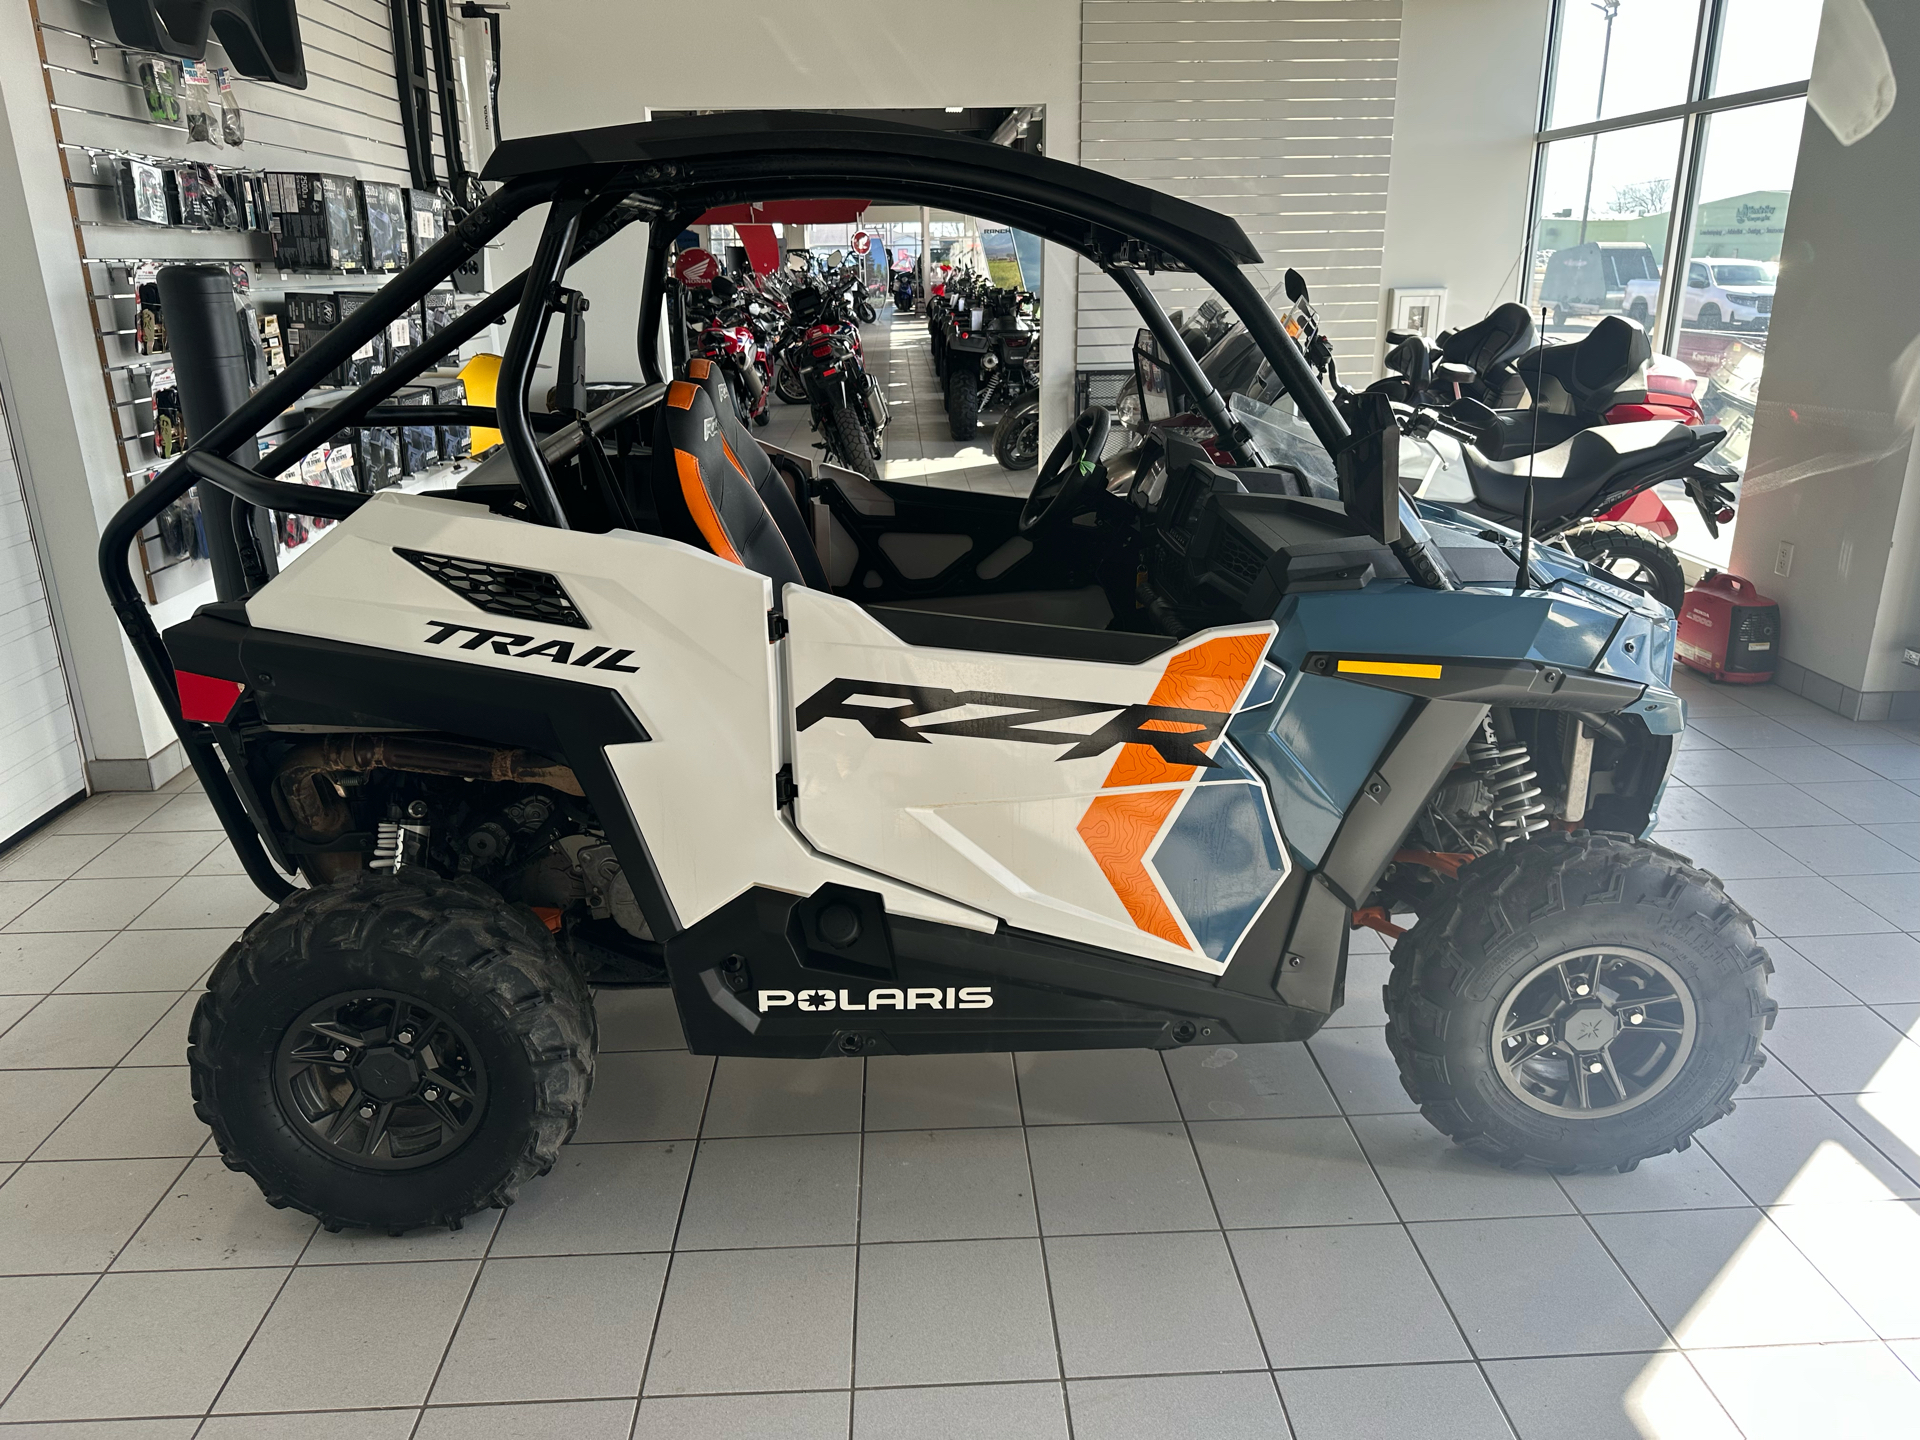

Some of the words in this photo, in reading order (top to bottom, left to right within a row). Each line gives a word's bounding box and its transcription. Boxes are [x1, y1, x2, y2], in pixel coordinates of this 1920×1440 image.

[1585, 578, 1633, 602] TRAIL
[1693, 608, 1710, 619] HONDA
[424, 620, 641, 674] TRAIL
[796, 677, 1233, 770] RZR
[758, 986, 994, 1014] POLARIS
